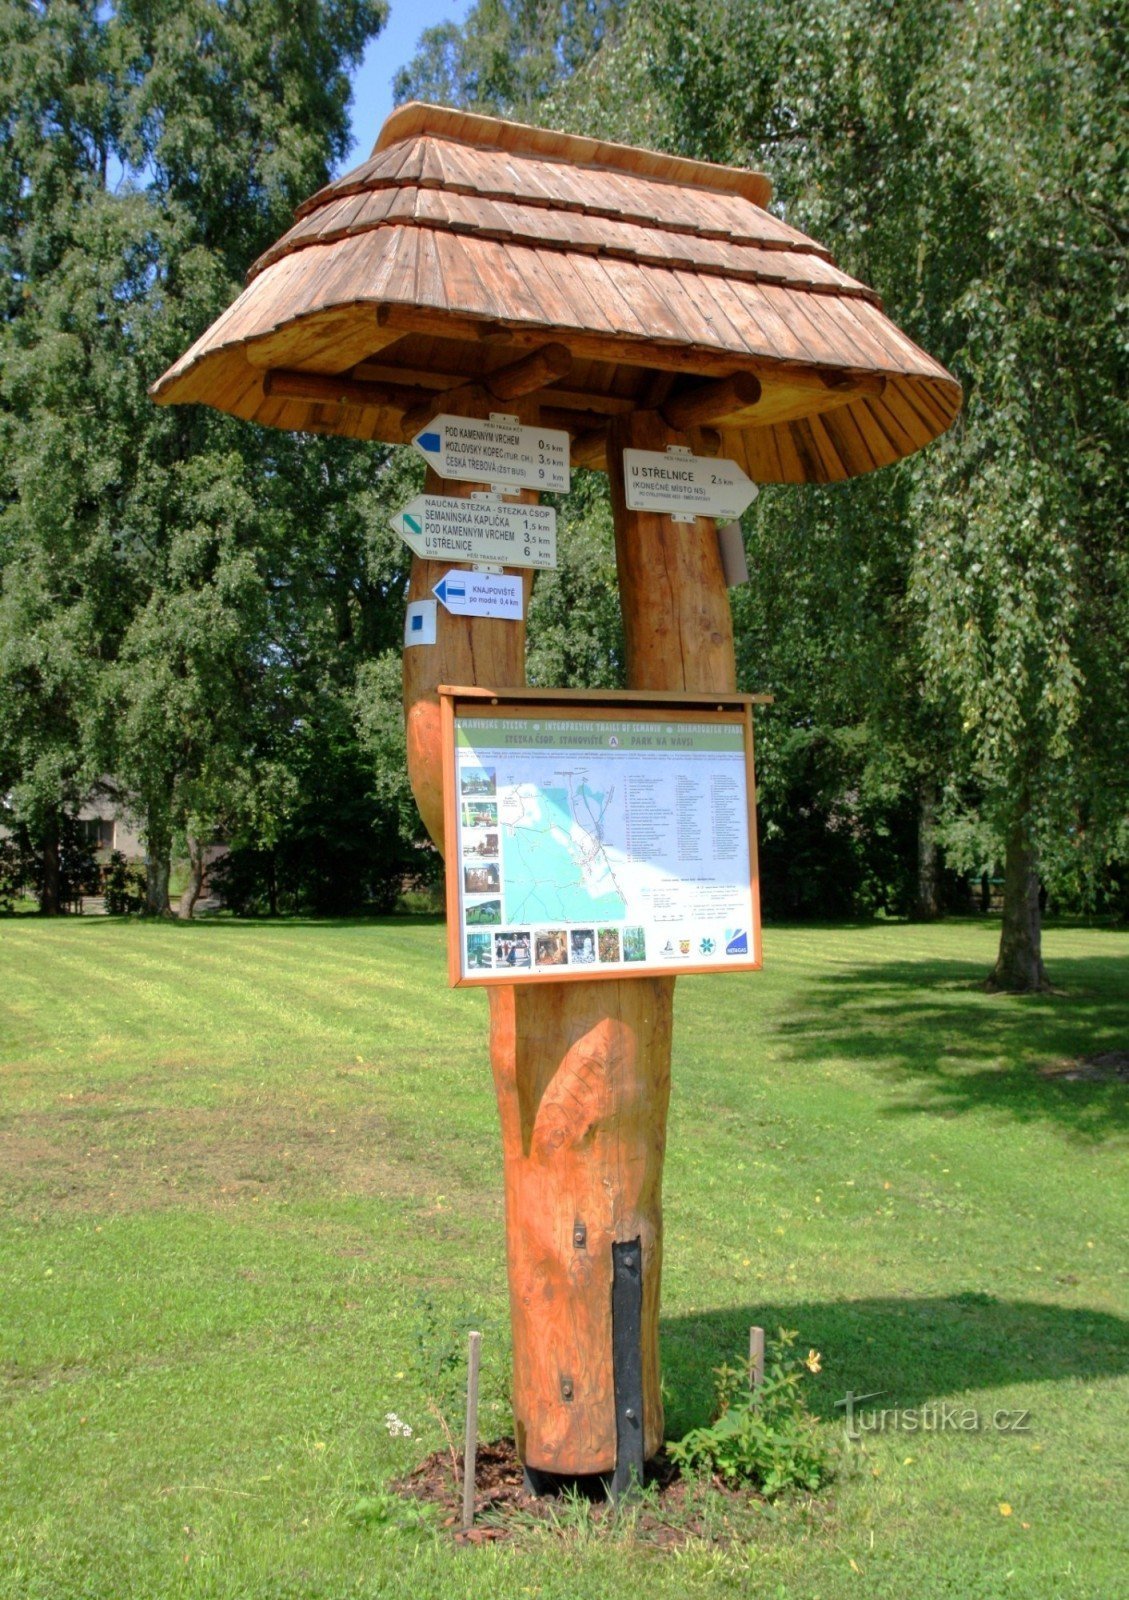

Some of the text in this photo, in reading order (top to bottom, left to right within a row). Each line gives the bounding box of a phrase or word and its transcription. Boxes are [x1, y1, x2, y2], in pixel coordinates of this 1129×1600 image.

[445, 426, 458, 437] POD
[459, 427, 494, 442] KAMENNÝM
[495, 434, 520, 446] VRCHEM
[446, 441, 482, 455] KOZLOVSKÝ
[483, 447, 503, 458] KOPEC
[553, 459, 563, 467] km
[446, 456, 466, 468] ČESKÁ
[468, 459, 496, 471] TŘEBOVÁ
[538, 469, 545, 479] 9
[553, 474, 564, 482] km
[632, 467, 638, 476] U
[642, 467, 694, 481] STŘELNICE
[723, 478, 734, 486] km
[633, 481, 668, 491] (KONEČNÉ
[671, 484, 692, 494] MÍSTO
[425, 499, 458, 509] NAUČNÁ
[462, 503, 491, 512] STEZKA
[497, 506, 527, 516] STEZKA
[529, 508, 550, 518] ČSOP
[425, 509, 472, 524] SEMANÍNSKÁ
[474, 515, 510, 528] KAPLIČKA
[538, 523, 550, 531] km
[425, 523, 440, 534] POD
[442, 525, 483, 538] KAMENNÝM
[486, 531, 515, 541] VRCHEM
[539, 537, 550, 545] km
[426, 537, 430, 547] U
[433, 537, 472, 551] STŘELNICE
[524, 547, 530, 557] 6
[505, 735, 534, 744] STEZKA
[631, 736, 652, 745] PARK
